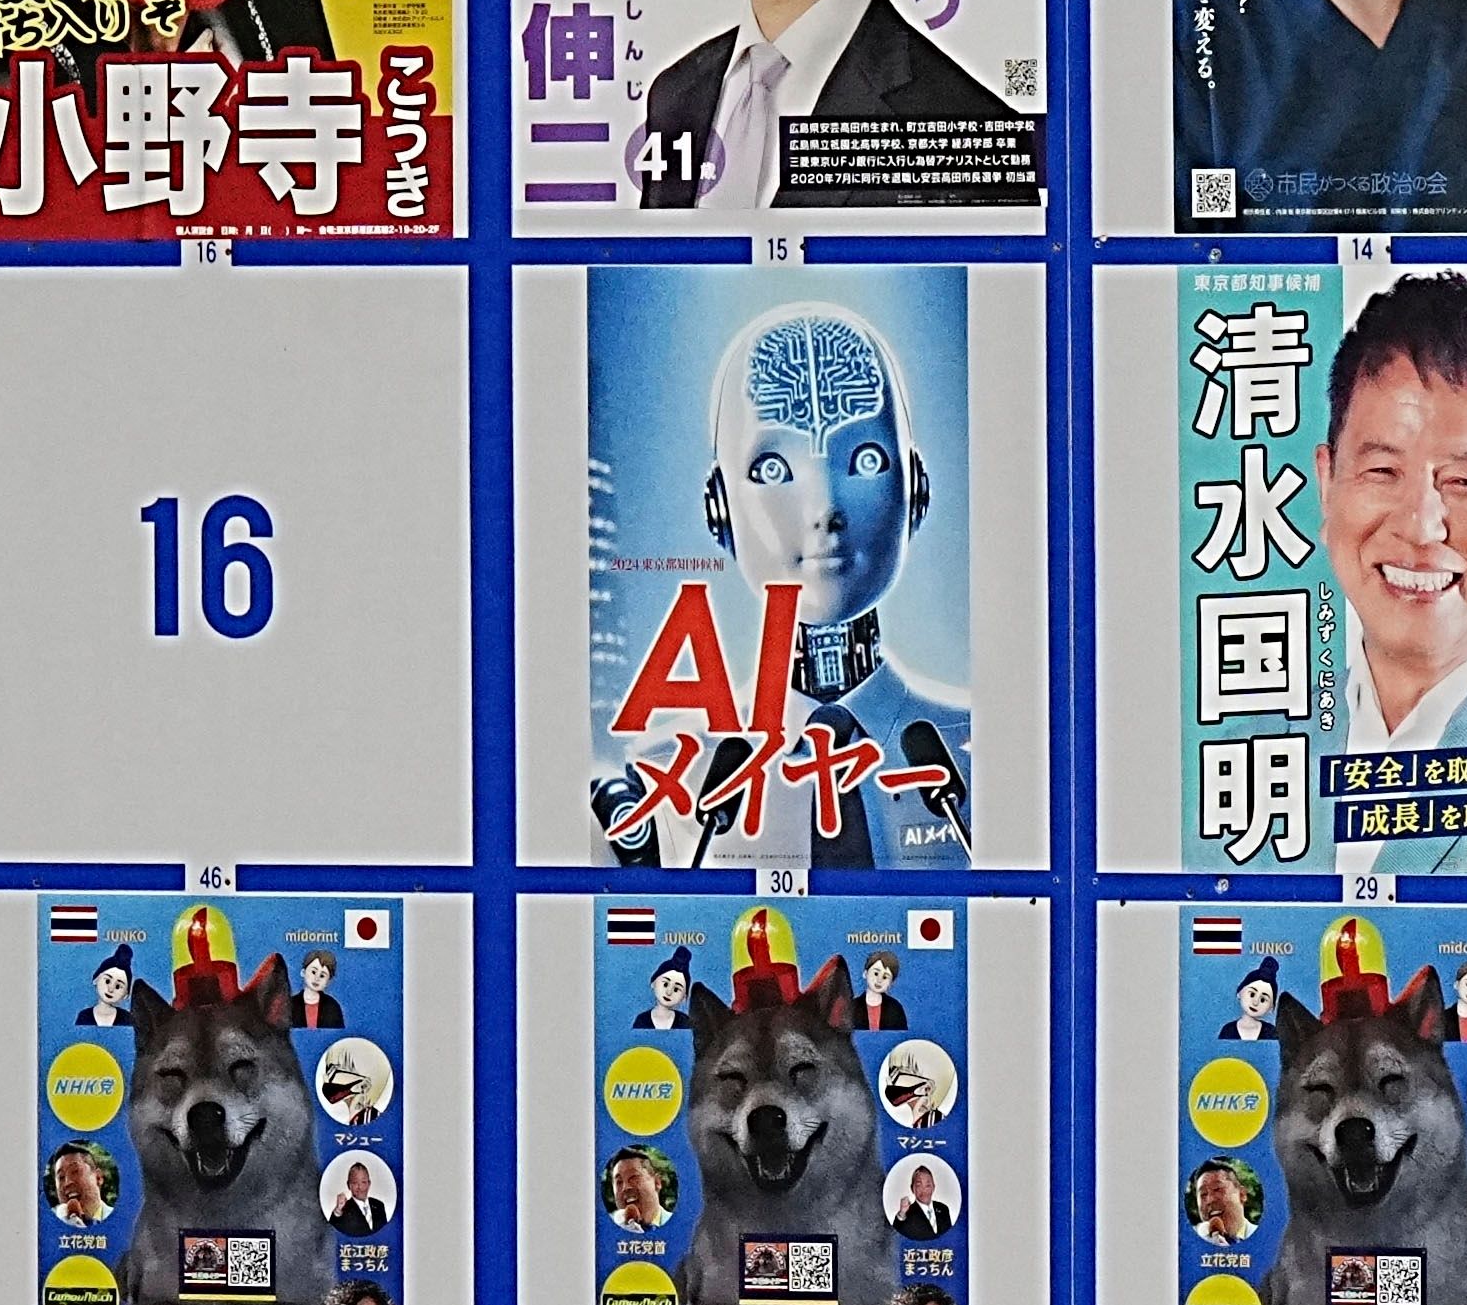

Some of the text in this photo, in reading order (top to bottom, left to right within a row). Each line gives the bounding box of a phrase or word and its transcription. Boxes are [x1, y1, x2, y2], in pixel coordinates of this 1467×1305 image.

[625, 0, 643, 102] しんじ
[386, 56, 429, 218] こうき
[1277, 170, 1448, 195] 市民がつくる政治の会
[1194, 274, 1321, 291] 東京都知事候補
[144, 496, 272, 638] 16
[1191, 302, 1311, 864] 清水国明
[609, 581, 804, 736] AI
[604, 723, 951, 838] メイヤー
[200, 867, 221, 888] 46
[771, 871, 792, 893] 30
